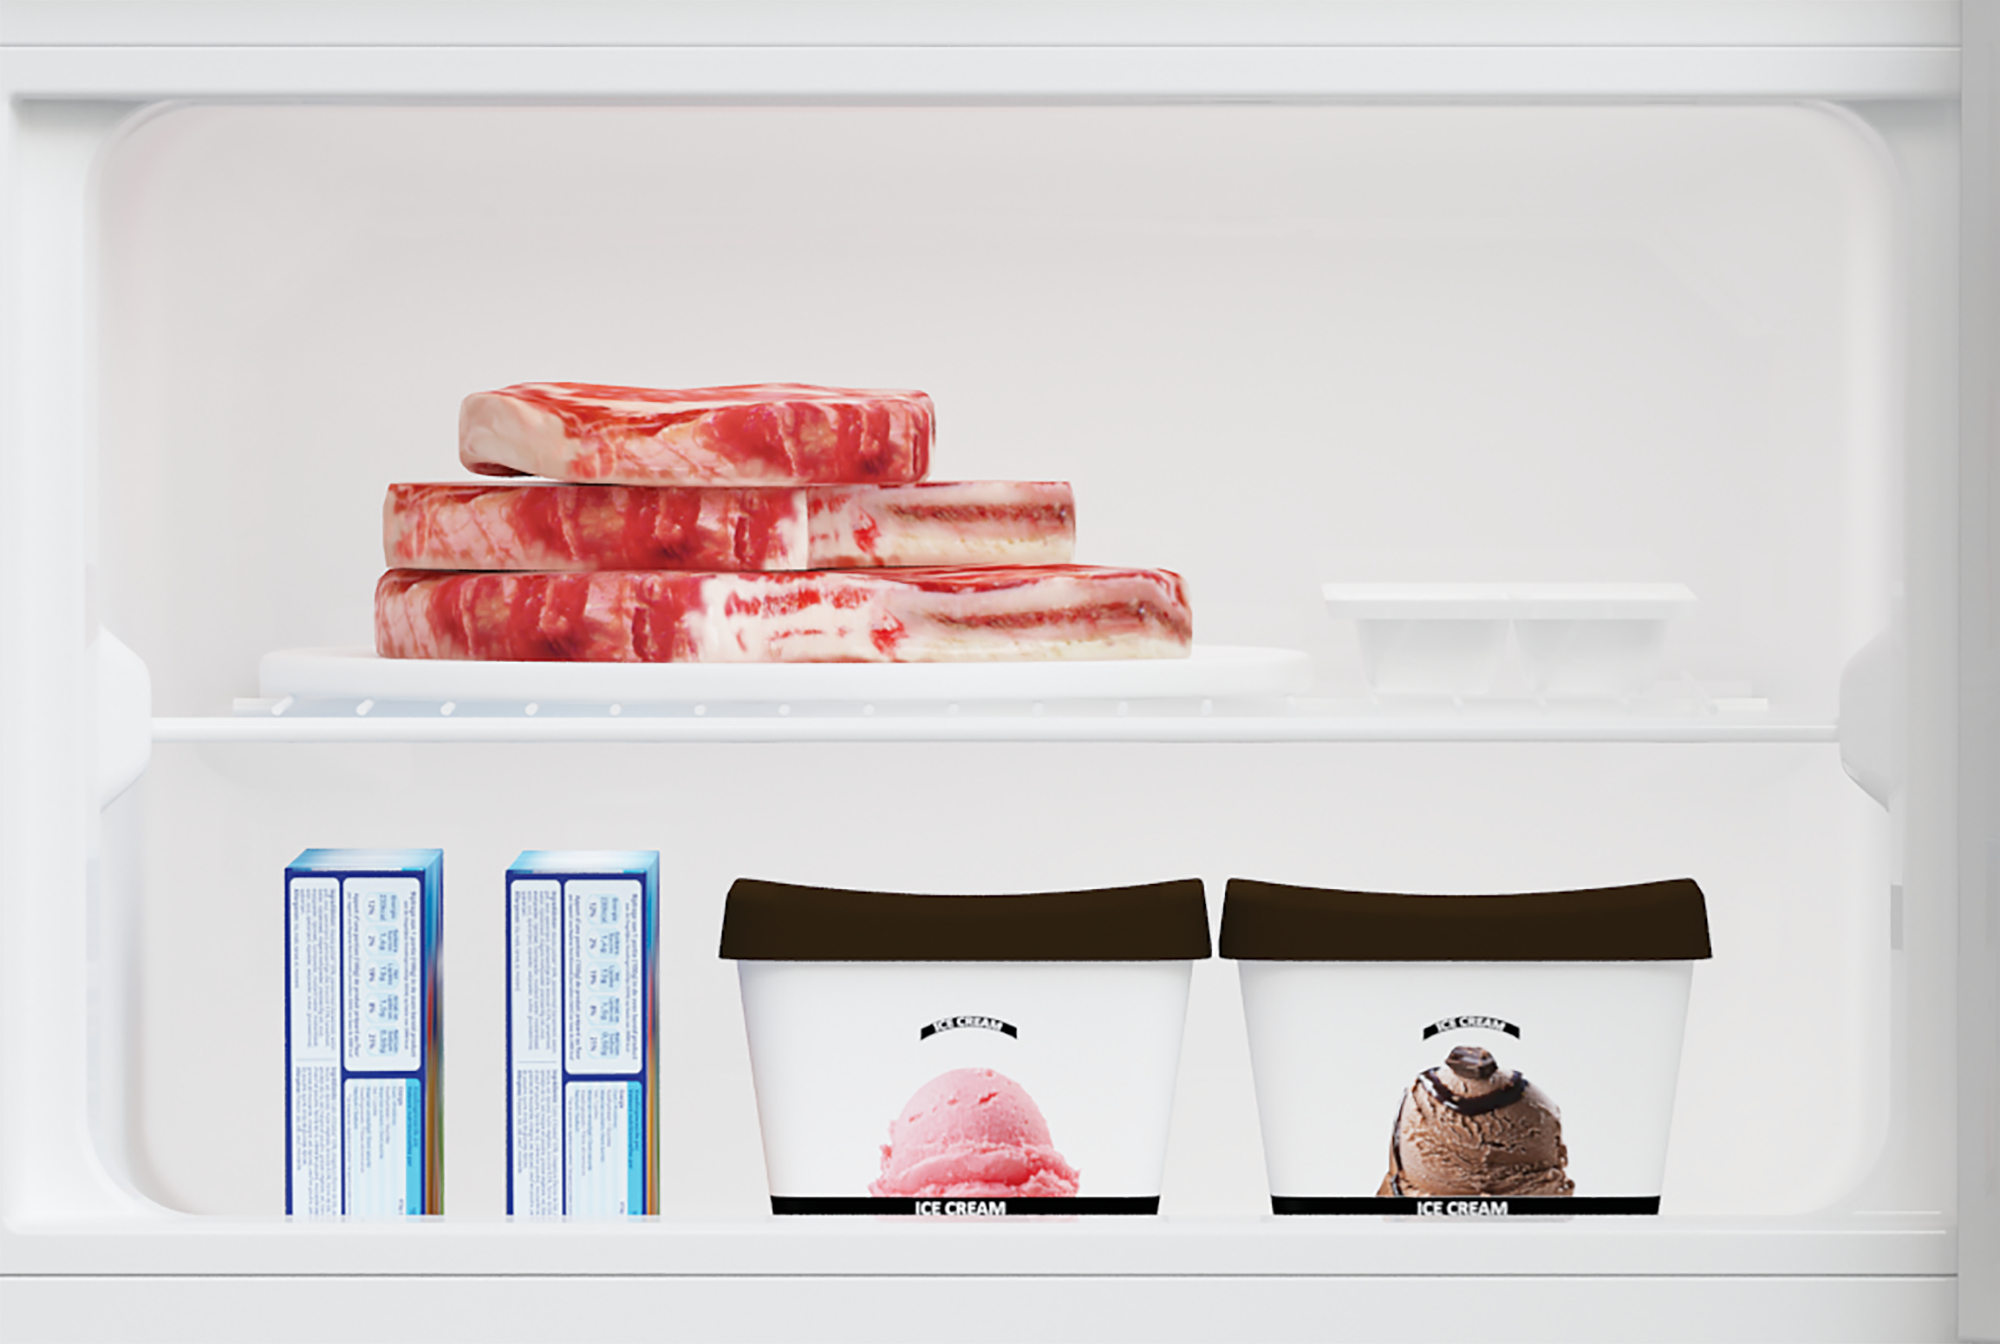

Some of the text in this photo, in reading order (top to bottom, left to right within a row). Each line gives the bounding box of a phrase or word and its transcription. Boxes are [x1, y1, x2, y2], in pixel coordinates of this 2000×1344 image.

[932, 1015, 1003, 1033] ICE CREAM
[1435, 1015, 1506, 1033] ICE CREAM
[915, 1201, 1007, 1216] ICE CREAM
[1417, 1201, 1509, 1216] ICE CREAM
